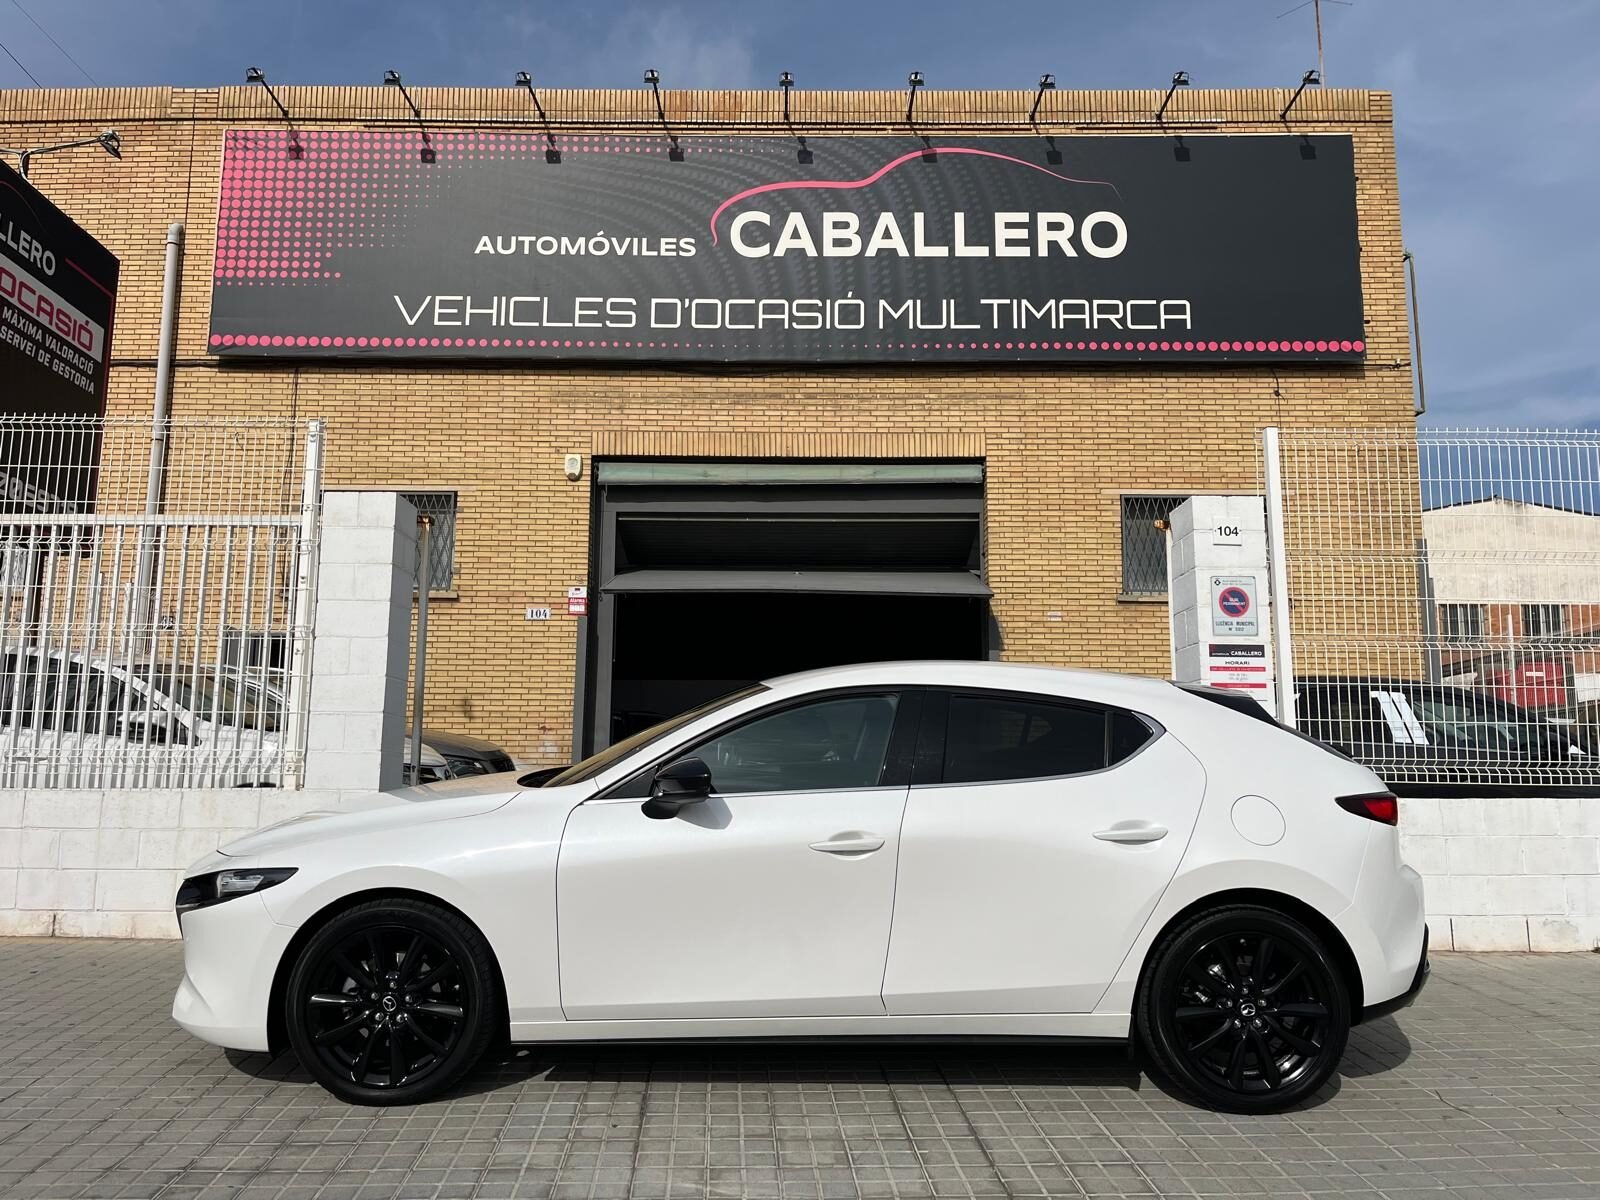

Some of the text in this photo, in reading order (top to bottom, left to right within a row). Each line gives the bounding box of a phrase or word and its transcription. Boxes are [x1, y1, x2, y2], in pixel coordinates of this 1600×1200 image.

[474, 210, 1128, 259] AUTOMÓVILES CABALLERO
[393, 291, 1192, 331] VEHICLES D'OCASIÓ MULTIMARCA
[0, 326, 95, 395] SERVEI DE GESTORIA
[2, 306, 94, 376] MÀXIMA VALORACIÓ
[1217, 525, 1239, 537] 104
[530, 609, 548, 619] 104
